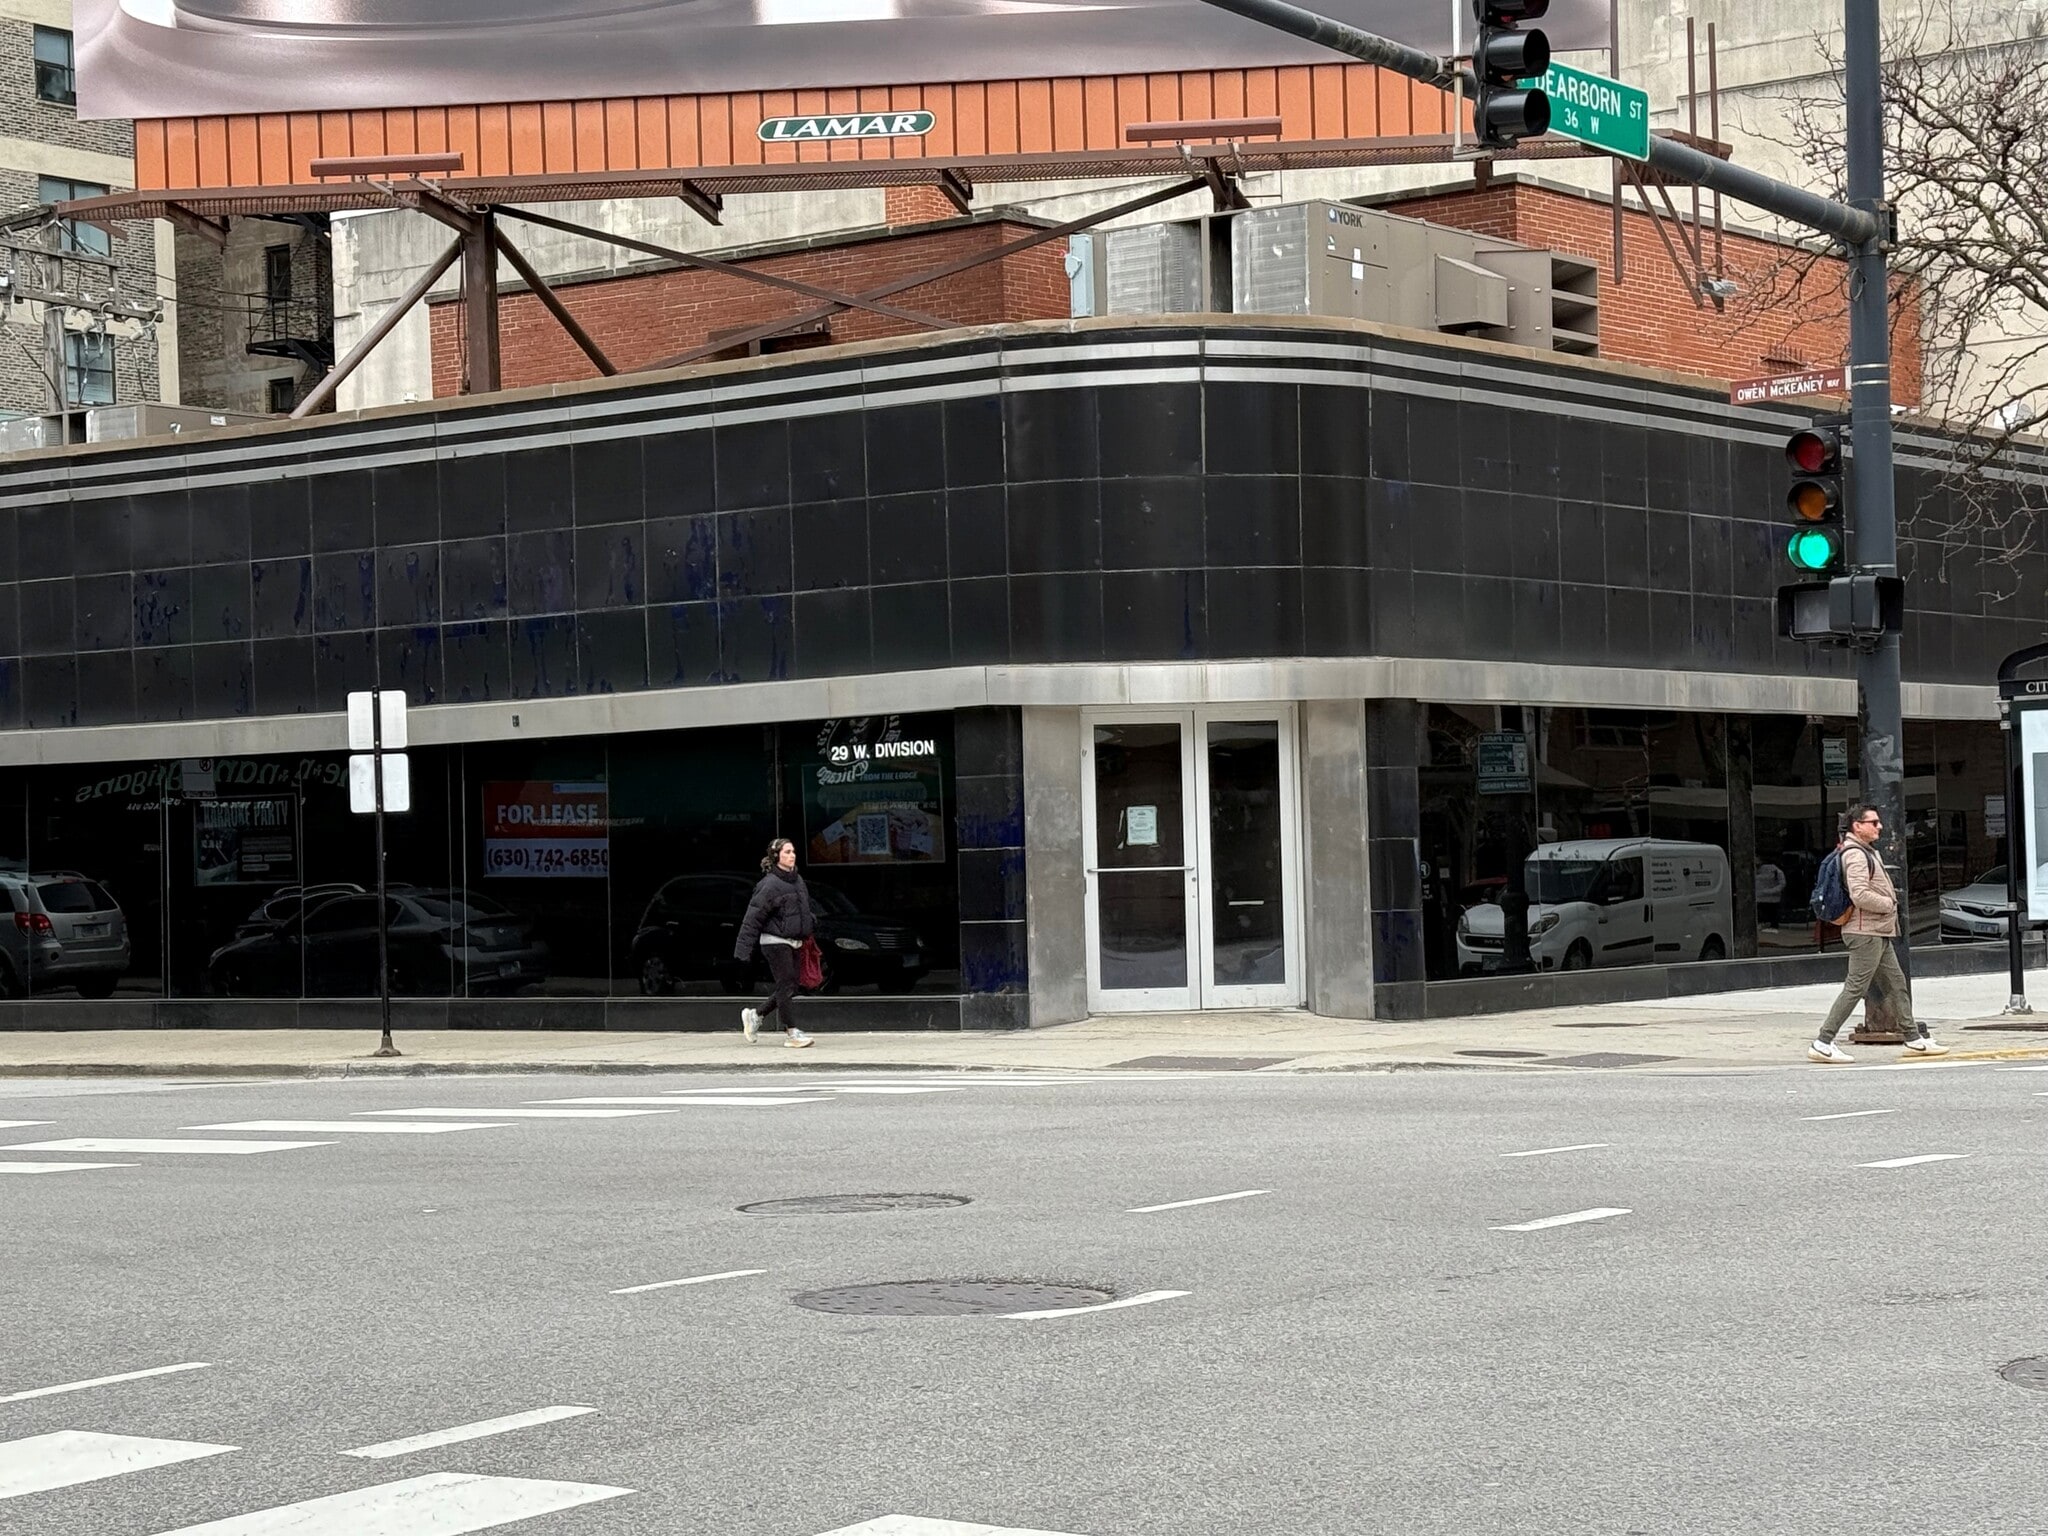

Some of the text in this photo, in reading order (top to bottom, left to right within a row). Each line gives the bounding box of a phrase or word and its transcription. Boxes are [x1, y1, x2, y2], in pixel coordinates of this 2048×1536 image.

[1564, 107, 1599, 134] 36 W
[1629, 100, 1642, 120] ST
[773, 114, 917, 138] LAMAR
[1337, 210, 1363, 228] YORK
[1737, 378, 1840, 400] OWEN McKEANEY WAY
[831, 740, 935, 761] 29 W. DIVISION
[253, 800, 289, 826] PARTY
[496, 804, 534, 825] FOR
[539, 803, 599, 823] LEASE
[487, 848, 608, 870] (630) 742-6850
